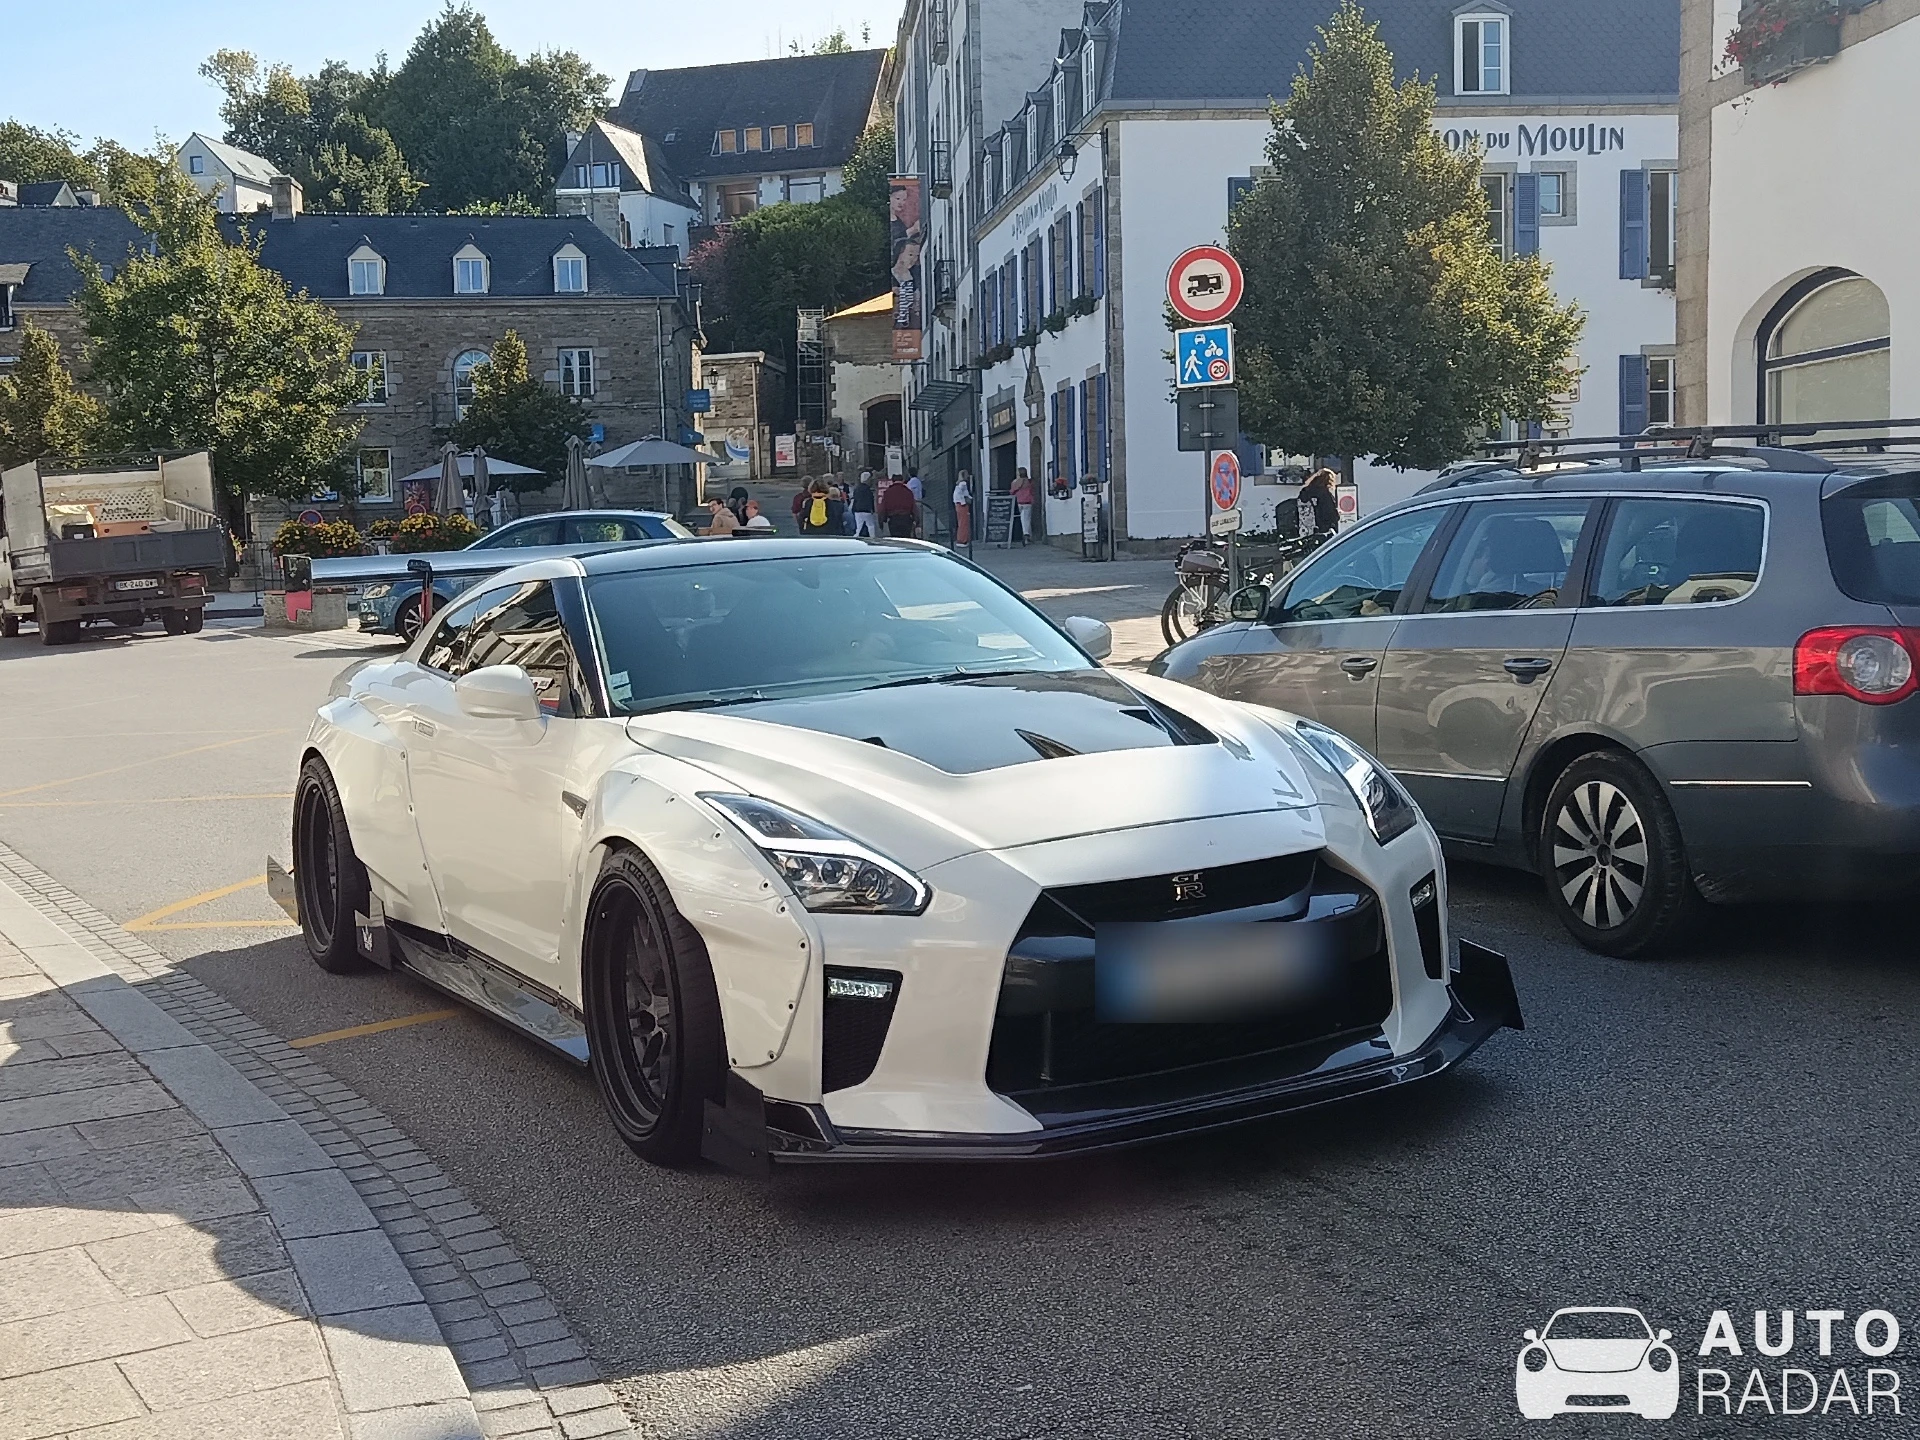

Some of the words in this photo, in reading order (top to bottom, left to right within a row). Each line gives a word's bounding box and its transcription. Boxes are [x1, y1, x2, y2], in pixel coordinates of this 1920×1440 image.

[1486, 132, 1510, 149] DU
[1517, 122, 1625, 156] MOULIN
[1213, 365, 1225, 375] 20
